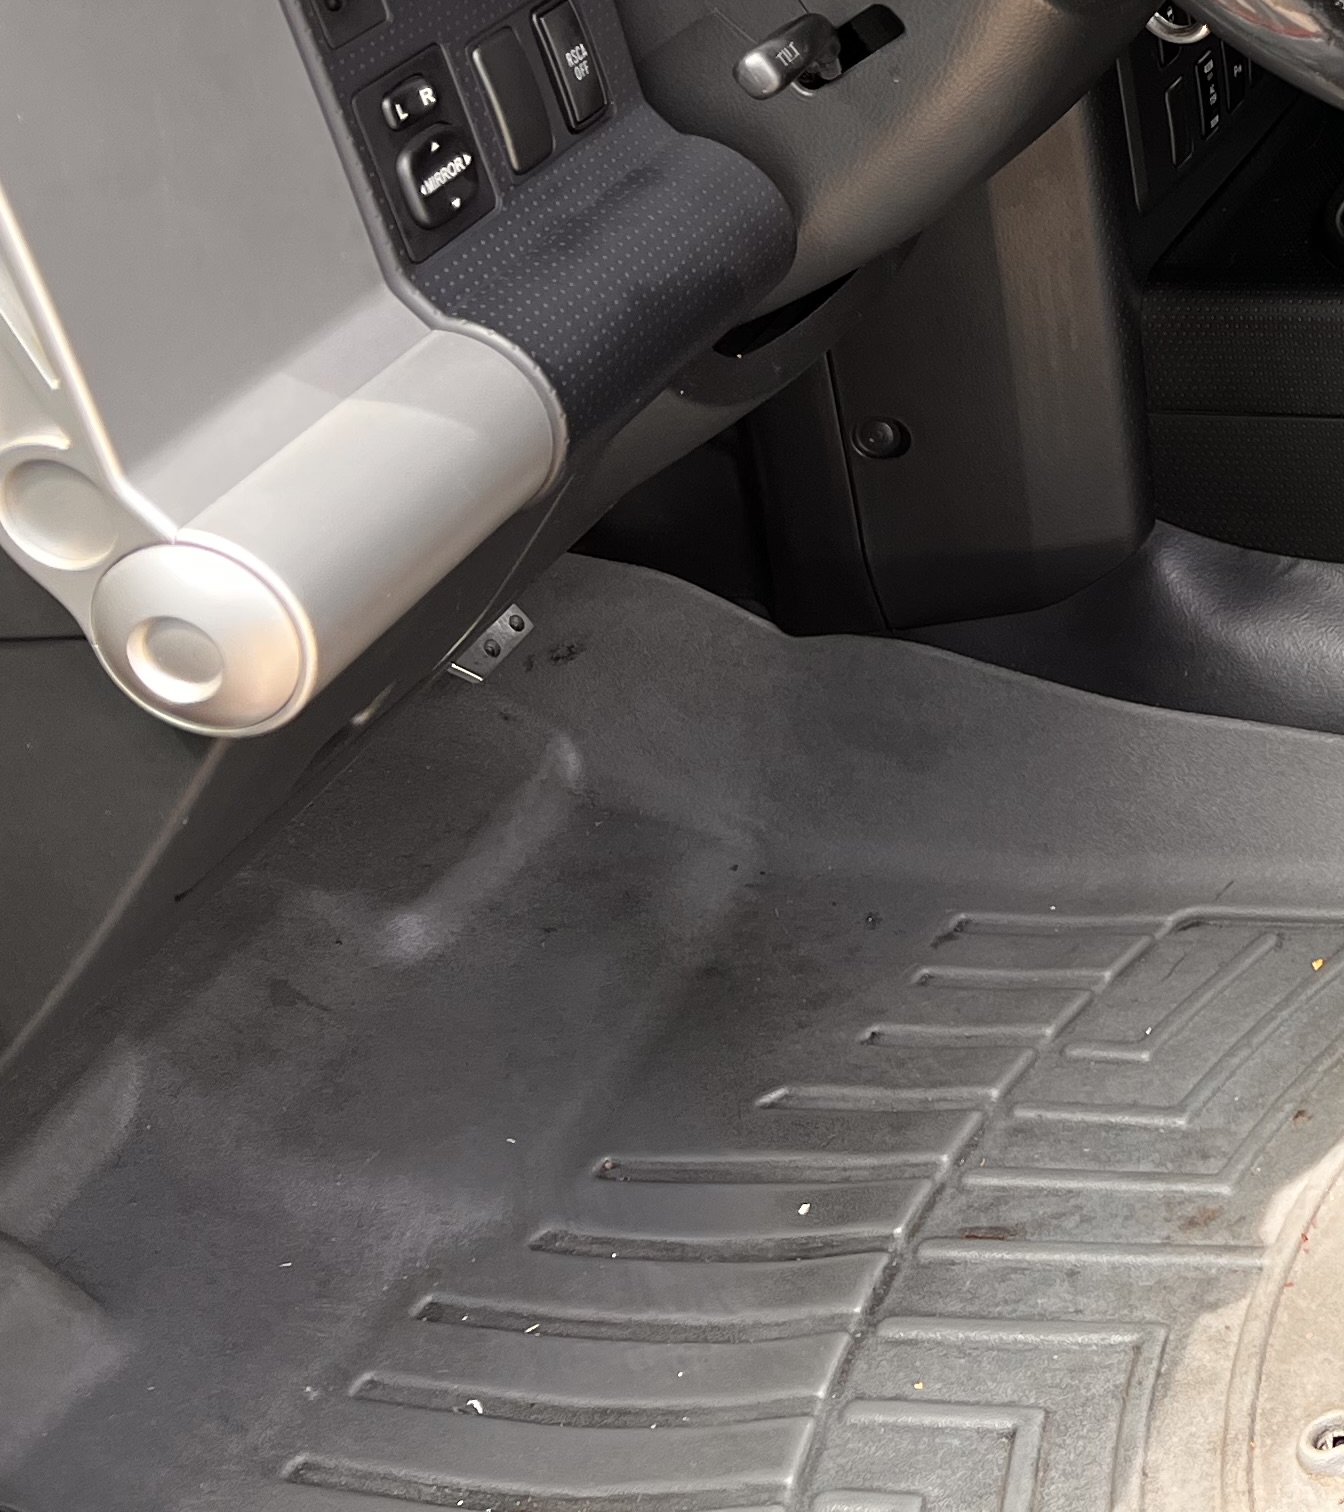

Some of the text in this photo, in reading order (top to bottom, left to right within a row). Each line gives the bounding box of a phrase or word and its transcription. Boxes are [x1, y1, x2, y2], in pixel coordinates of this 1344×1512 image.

[565, 43, 588, 68] RSCA
[776, 41, 801, 66] TILT
[574, 60, 590, 81] OFF
[395, 87, 436, 120] L R
[423, 156, 467, 194] MIRROR
